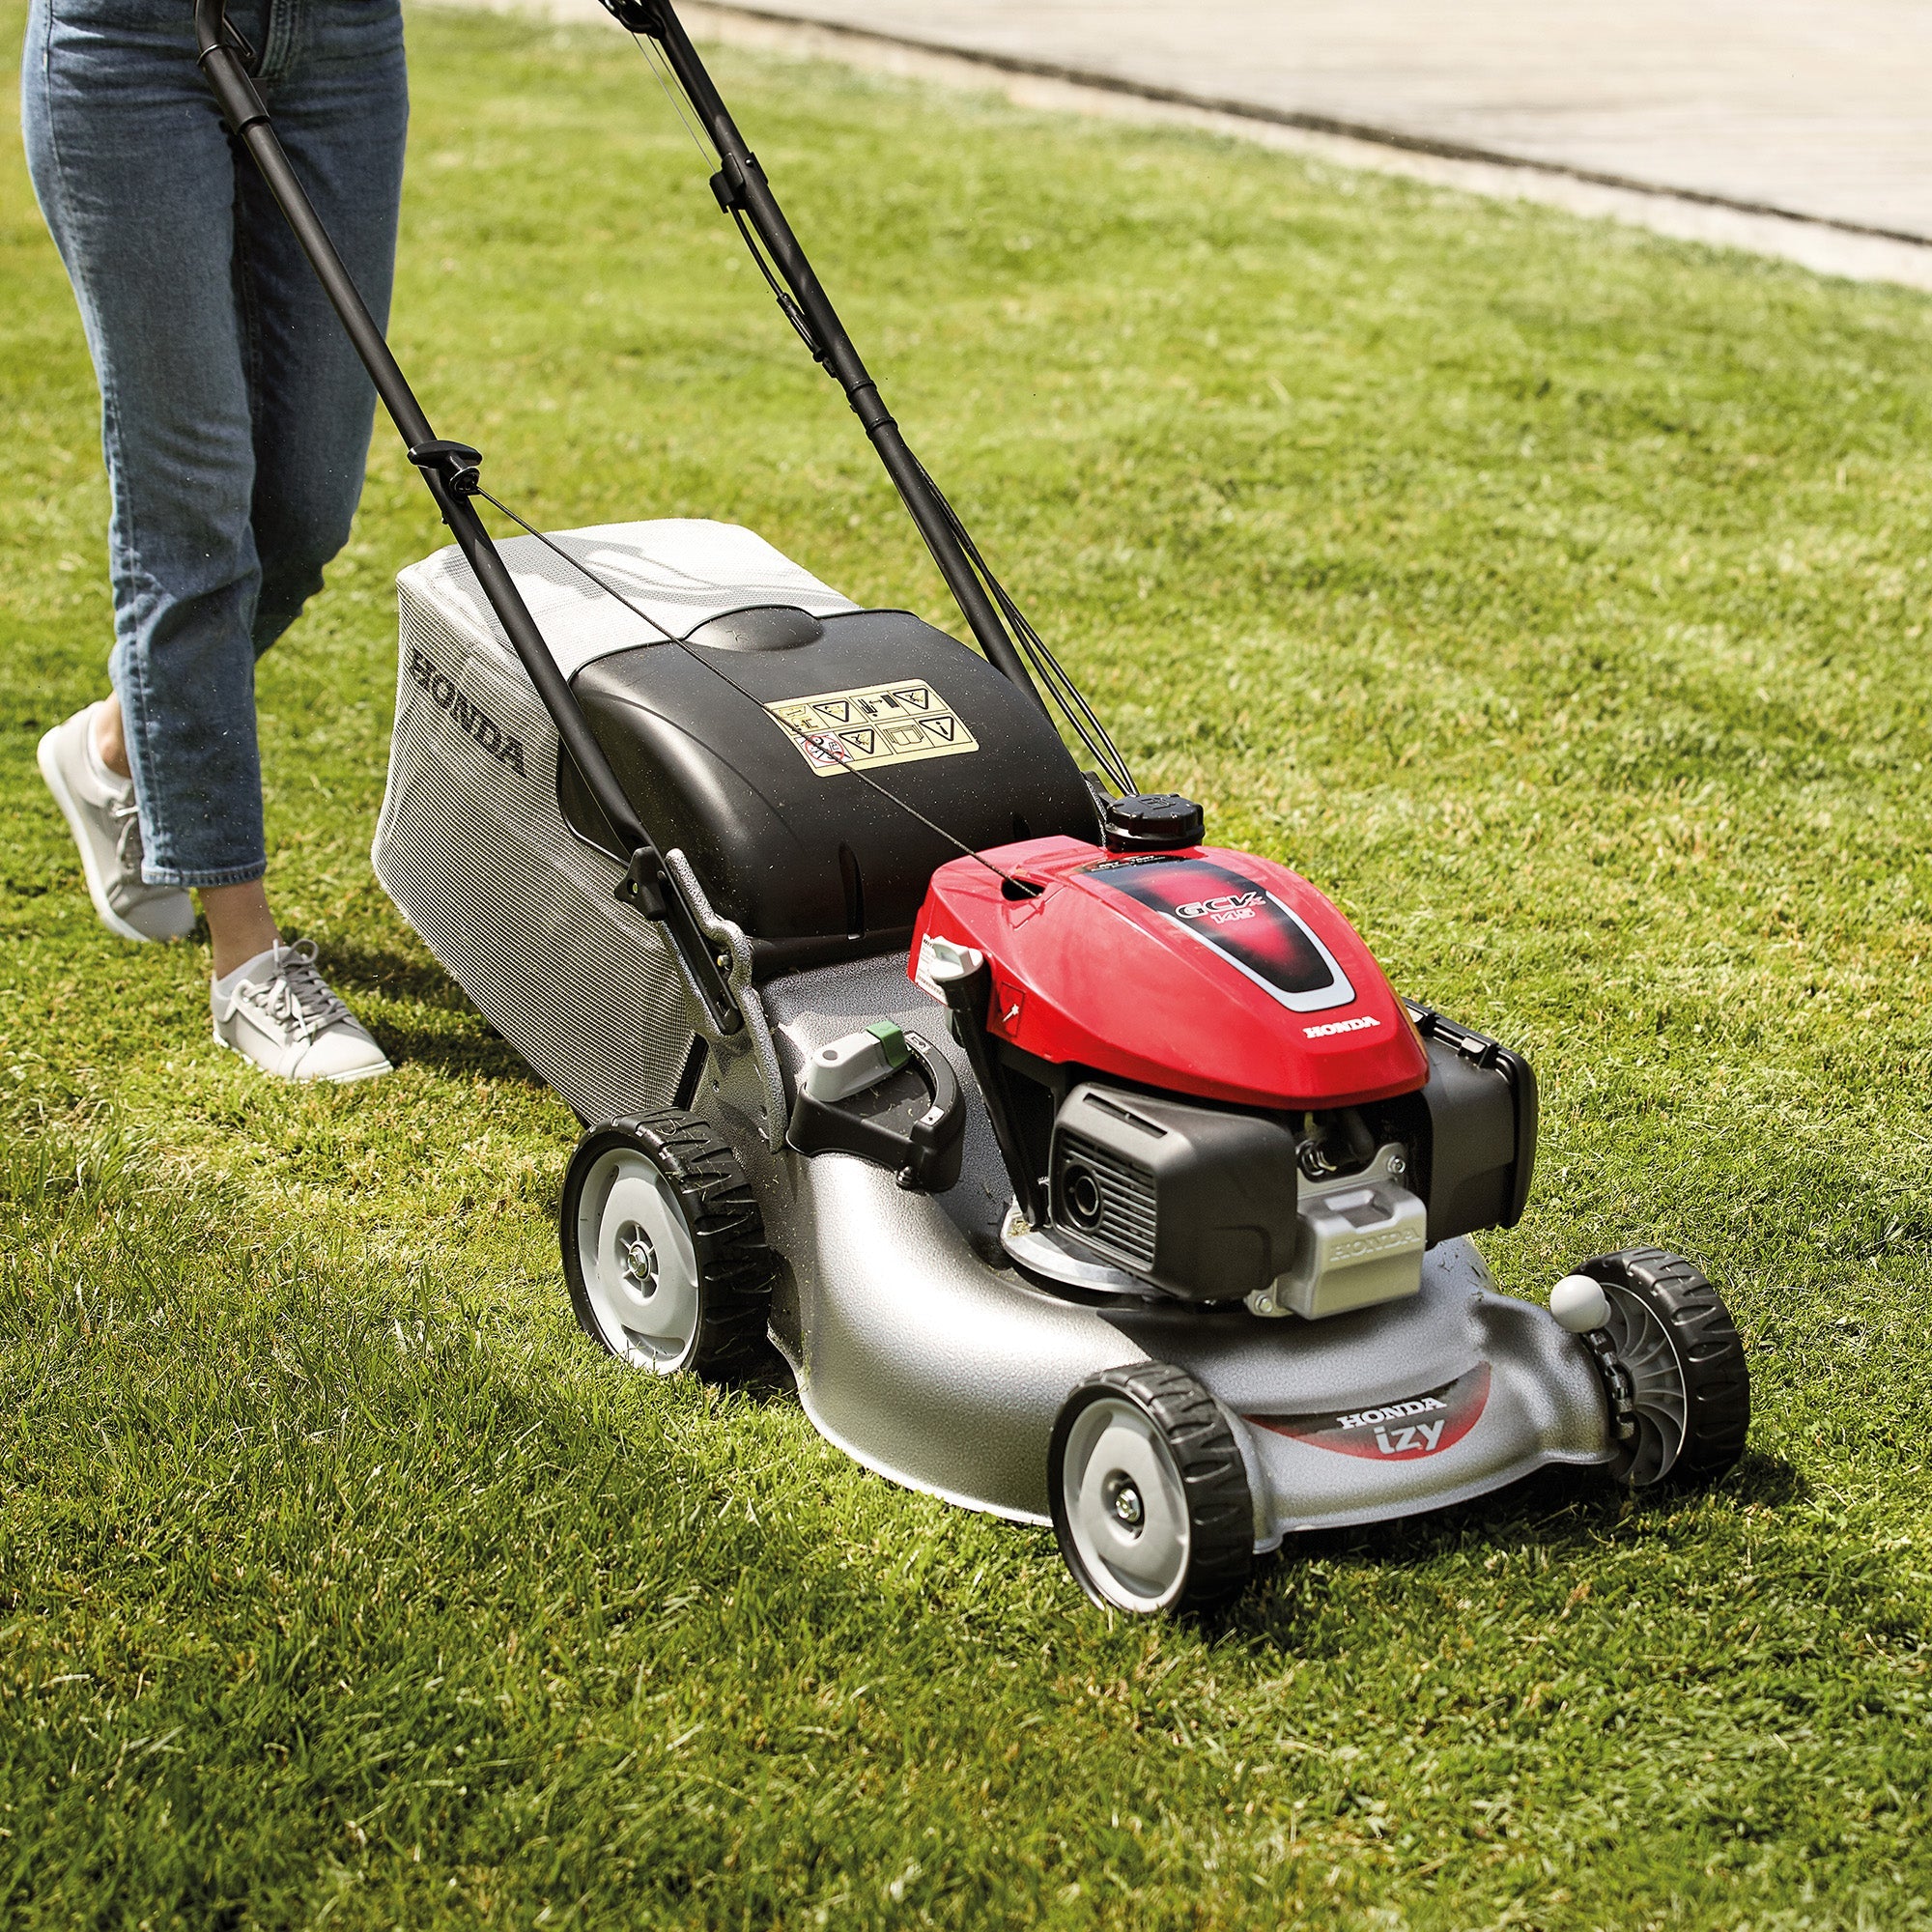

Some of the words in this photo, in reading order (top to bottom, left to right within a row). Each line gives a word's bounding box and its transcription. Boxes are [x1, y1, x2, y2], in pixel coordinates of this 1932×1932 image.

[410, 647, 527, 779] HONDA
[1302, 1015, 1381, 1039] HONDA
[1329, 1227, 1421, 1262] HONDA
[1336, 1397, 1448, 1430] HONDA
[1373, 1419, 1446, 1455] izy
